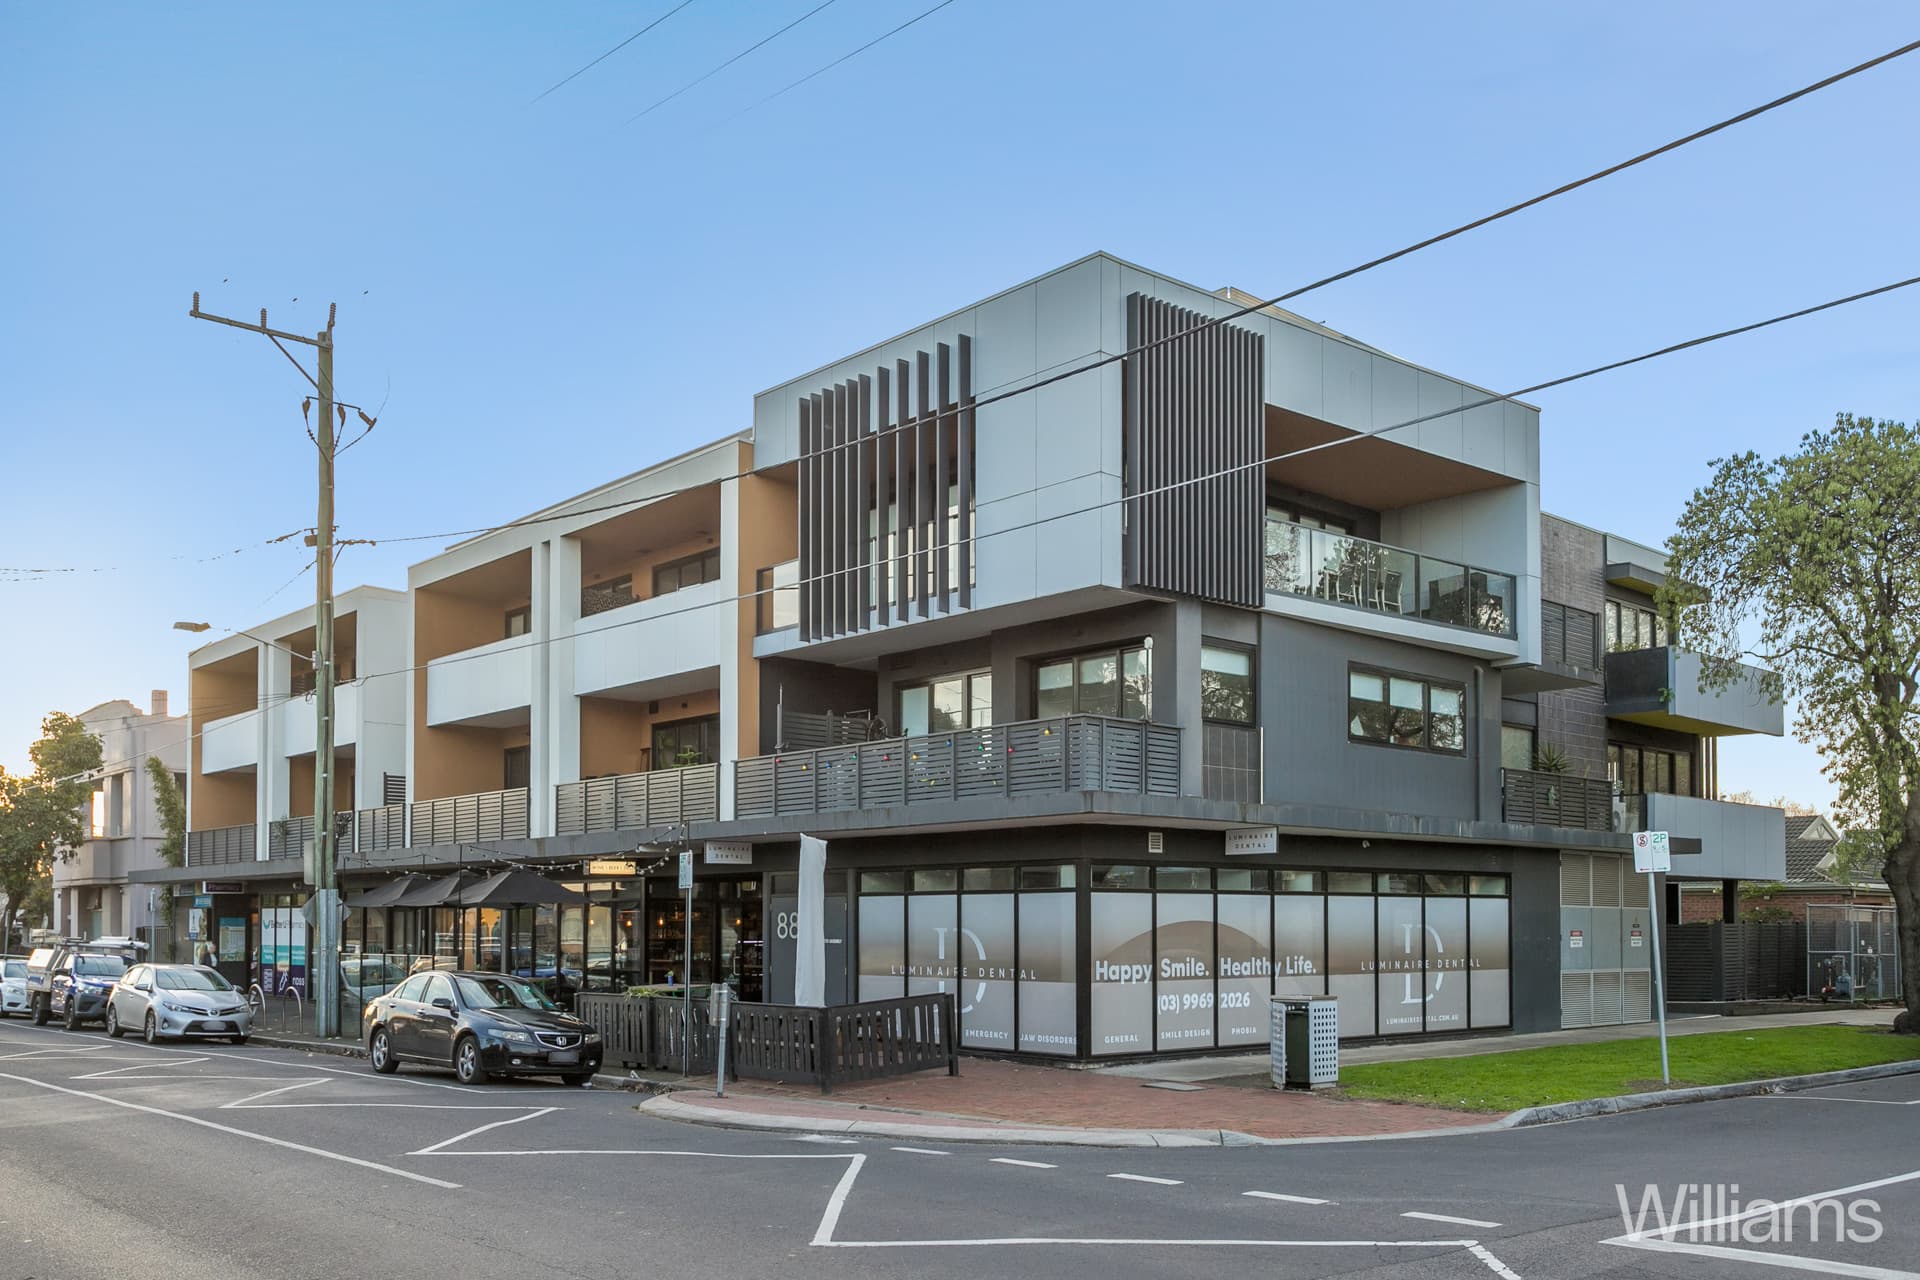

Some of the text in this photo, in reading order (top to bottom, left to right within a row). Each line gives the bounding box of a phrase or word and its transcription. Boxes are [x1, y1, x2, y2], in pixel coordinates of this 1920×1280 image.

[1229, 833, 1273, 841] LUMINAIRE
[1652, 833, 1667, 843] 2P
[777, 911, 798, 939] 88
[1361, 958, 1481, 971] LUMINAIRE DENTAL
[891, 965, 1037, 980] LUMINAIRE DENTAL
[1095, 960, 1153, 985] Happy
[1160, 957, 1210, 978] Smile.
[1286, 955, 1317, 975] Life.
[1157, 991, 1250, 1015] (03) 9969 2026
[965, 1029, 1009, 1039] EMERGENCY
[1160, 1028, 1211, 1039] SMILE DESIGN
[1231, 1026, 1257, 1035] PHOBIA
[1020, 1033, 1035, 1042] JAW
[1104, 1034, 1139, 1044] GENERAL
